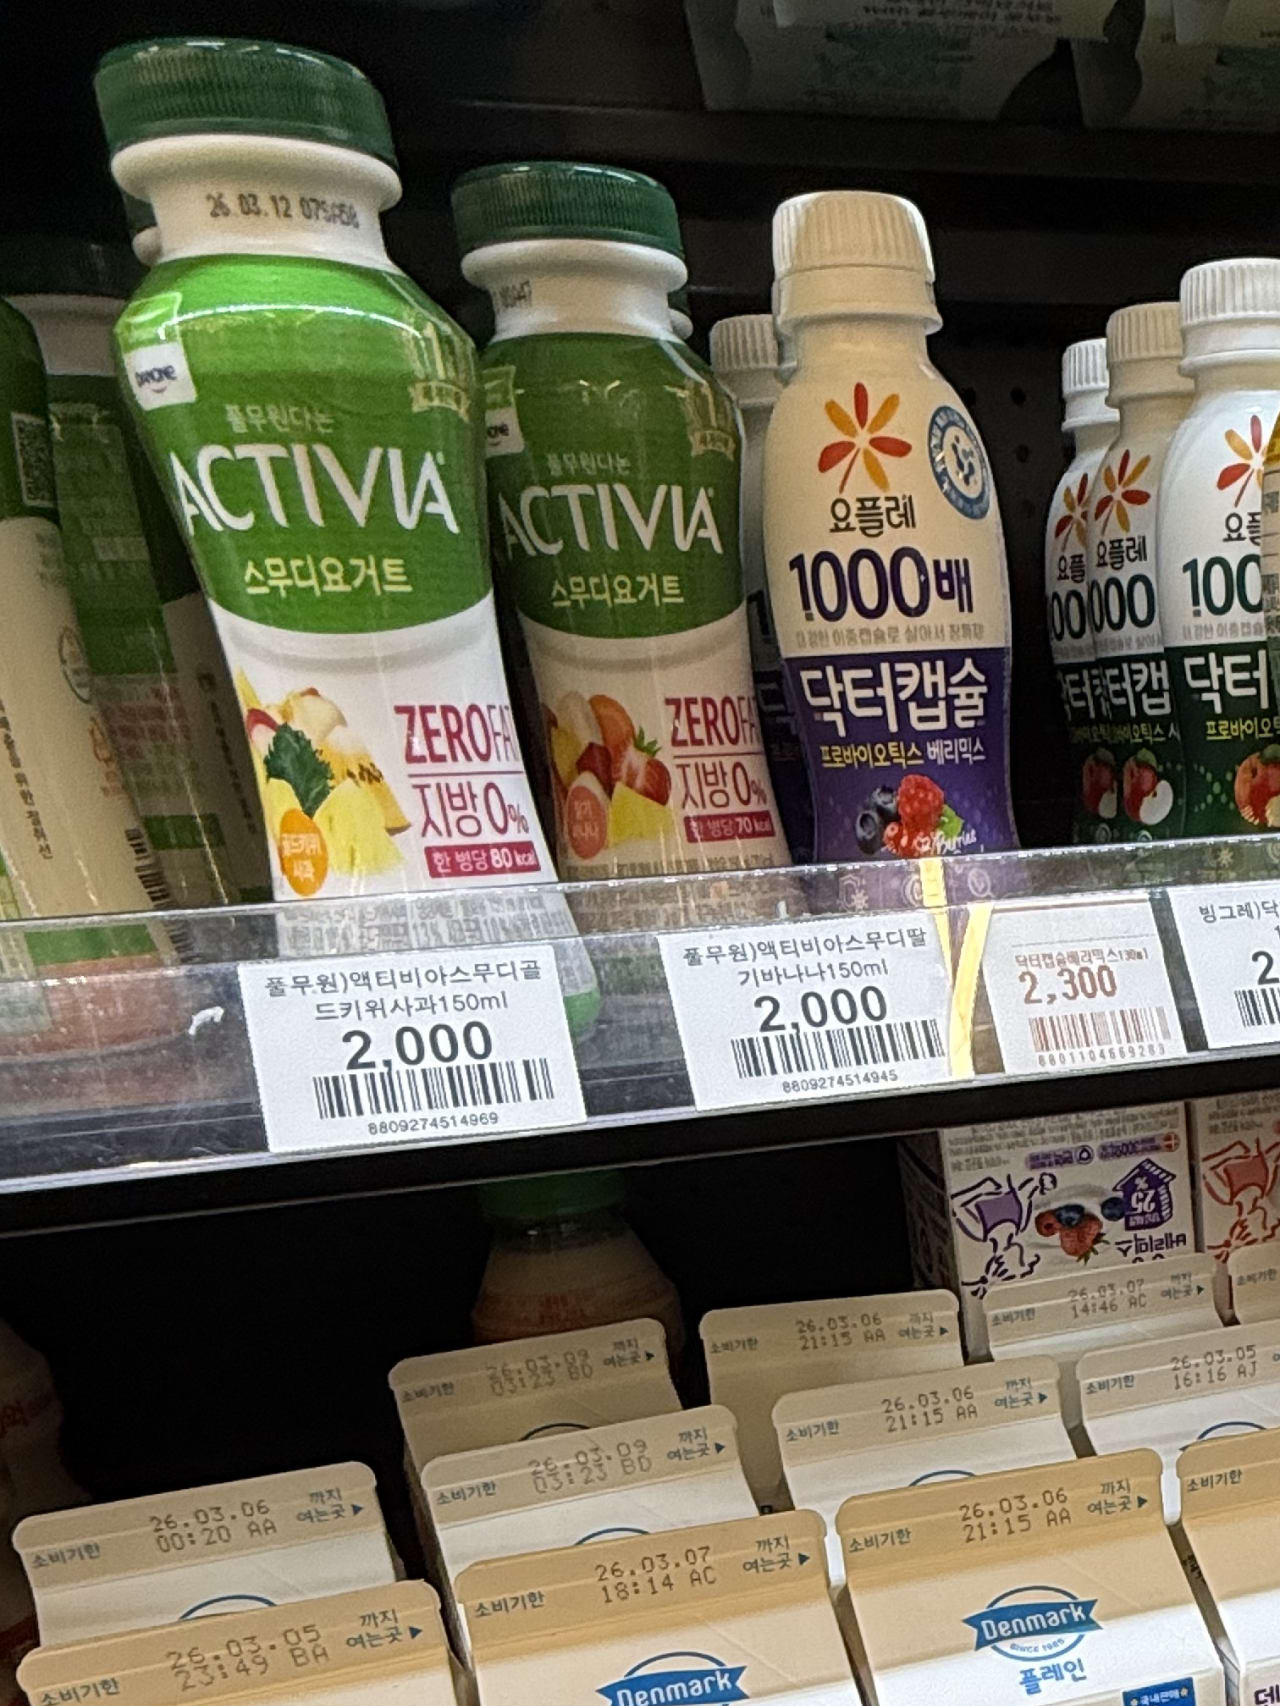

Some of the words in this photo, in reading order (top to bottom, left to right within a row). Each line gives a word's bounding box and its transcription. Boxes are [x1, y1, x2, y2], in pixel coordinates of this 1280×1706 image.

[169, 443, 460, 537] ACTIVIA
[501, 484, 724, 561] ACTIVIA
[829, 496, 916, 534] 요플레
[244, 556, 412, 599] 스무디요거트
[552, 572, 684, 607] 스무디요거트
[801, 658, 988, 737] 닥터캡슐
[394, 703, 521, 764] ZEROFA
[821, 741, 923, 769] 프로바이오틱스
[927, 740, 986, 765] 베리믹스
[432, 850, 451, 873] 한
[455, 848, 489, 872] 병당
[489, 847, 514, 870] 80
[683, 927, 927, 966] 풀무원)액티비아스무디딸
[264, 961, 543, 997] 풀무원)액티비아스무디골
[738, 960, 889, 988] 기바나나150ml
[1018, 966, 1118, 1006] 2,300
[314, 991, 509, 1021] 드키위사과150ml
[754, 986, 888, 1033] 2,000
[342, 1021, 493, 1072] 2,000
[782, 1070, 898, 1094] 8809274514945
[368, 1112, 499, 1135] 8809274514969
[958, 1488, 1068, 1522] 26.03.06
[755, 1536, 789, 1551] 까지
[963, 1514, 1032, 1544] 21:15
[1047, 1508, 1072, 1527] AA
[595, 1545, 712, 1581] 26.03.07
[742, 1552, 793, 1573] 여는곳
[600, 1573, 674, 1604] 18:14
[690, 1567, 717, 1586] AC
[474, 1591, 545, 1617] 소비기한
[982, 1603, 1087, 1641] Denmark
